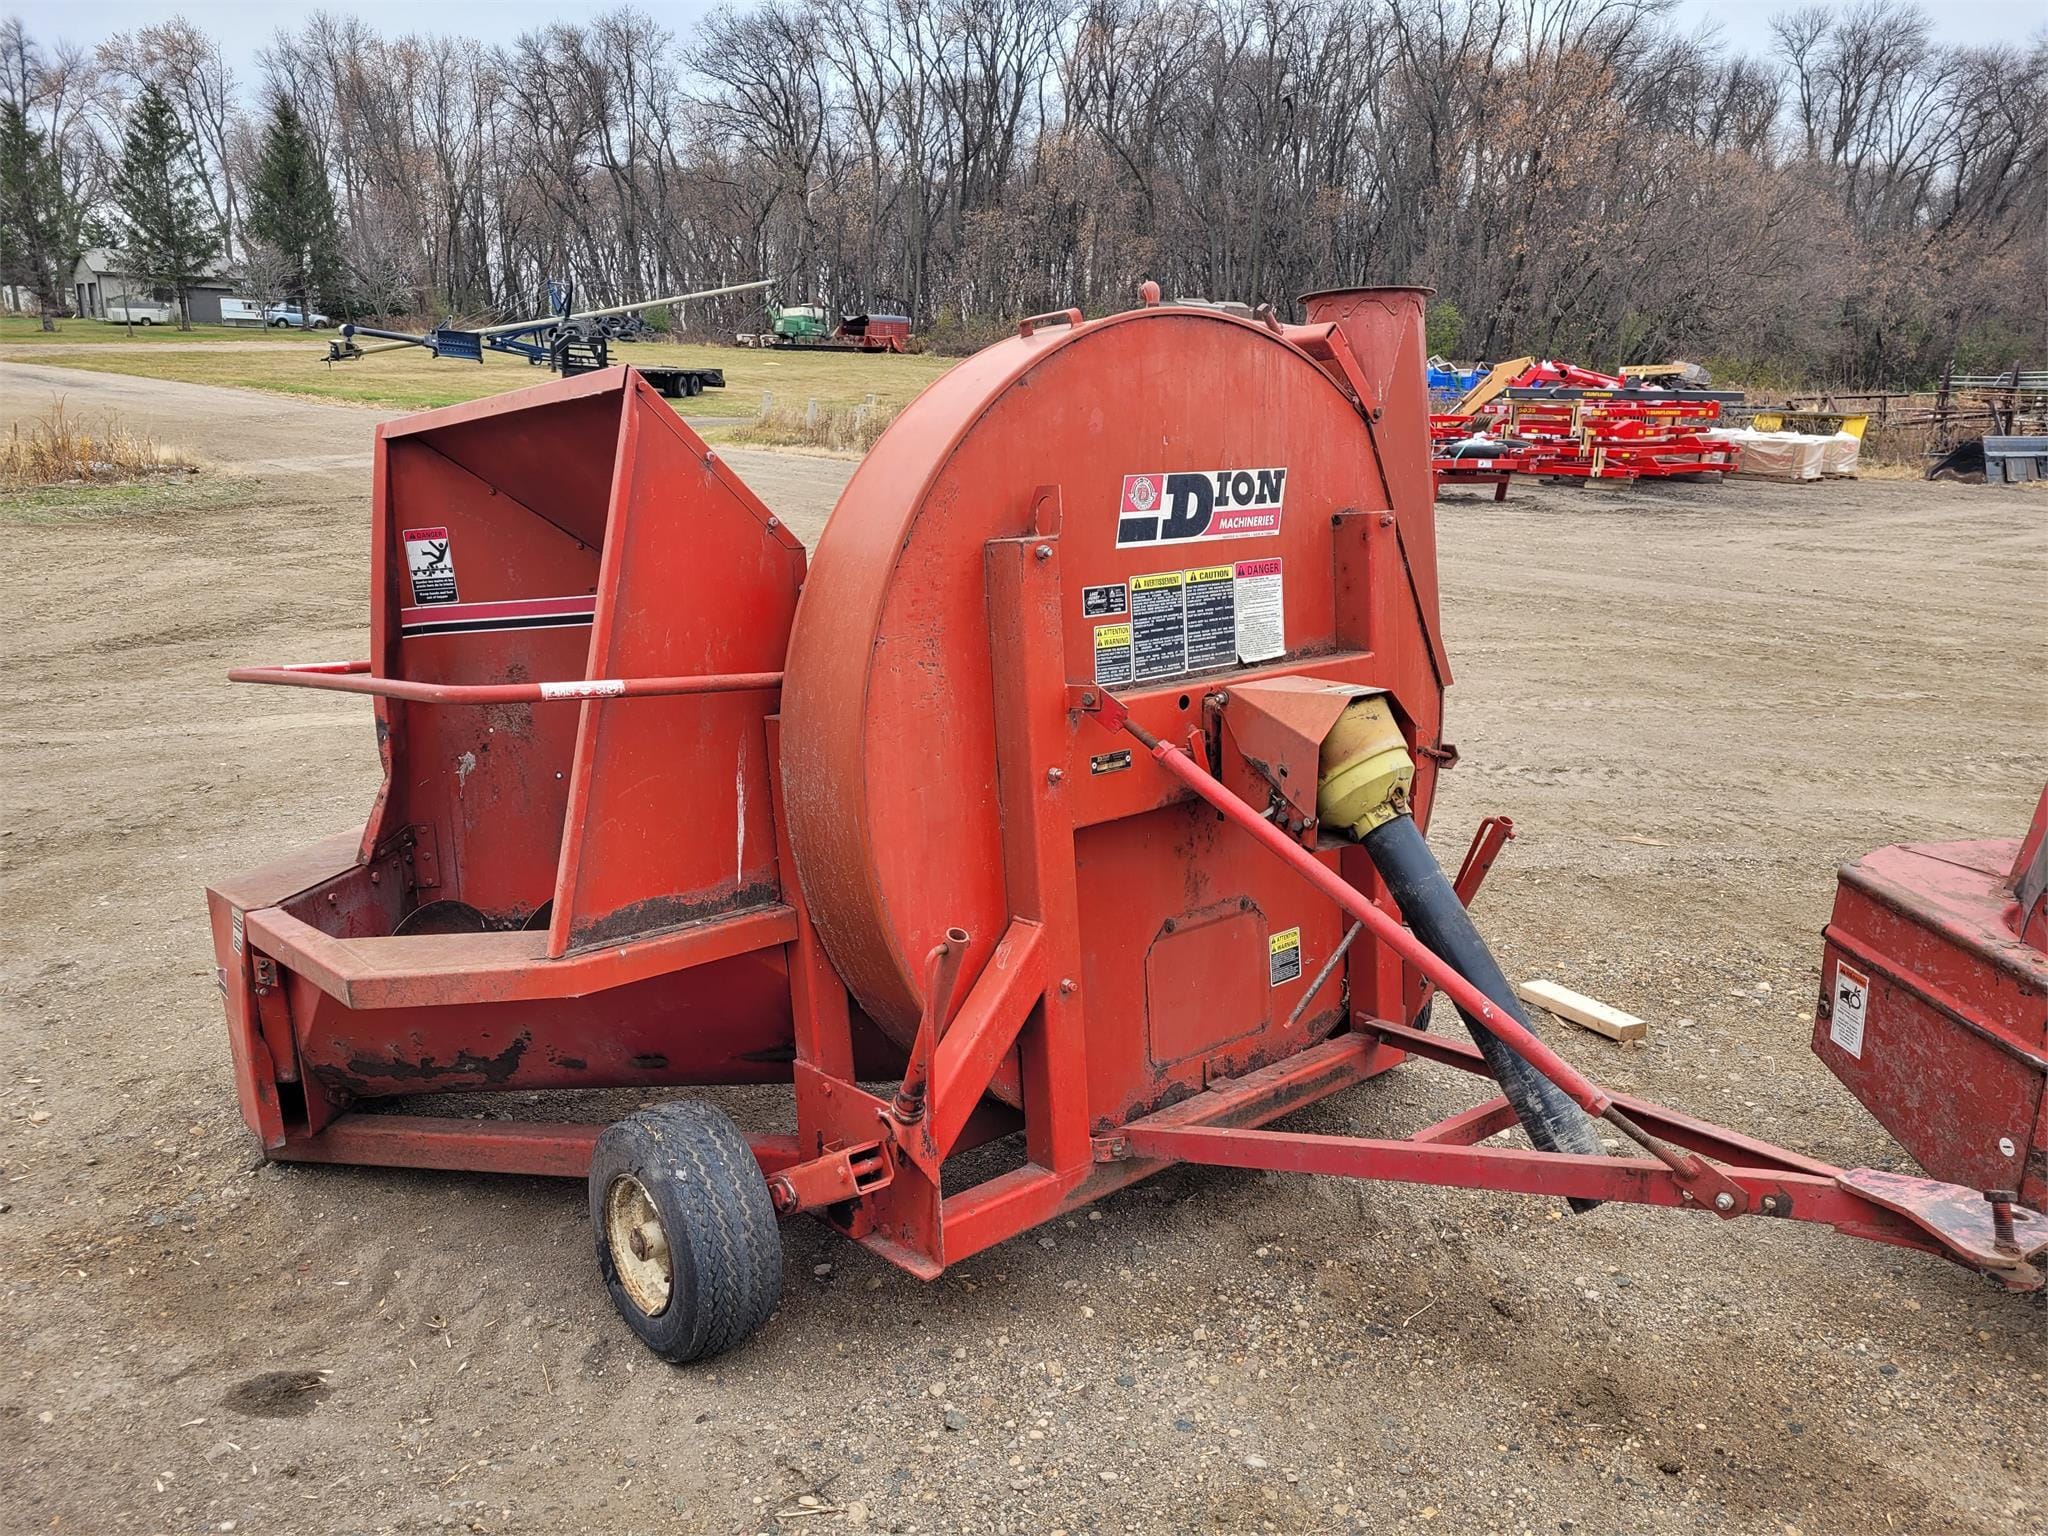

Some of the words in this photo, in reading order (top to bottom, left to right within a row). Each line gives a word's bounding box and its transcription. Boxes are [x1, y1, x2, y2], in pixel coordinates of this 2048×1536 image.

[1160, 469, 1285, 540] DION
[1219, 514, 1275, 530] MACHINERIES
[1199, 569, 1230, 580] CAUTION
[1247, 562, 1280, 576] DANGER
[1143, 576, 1180, 588] AVERTISSEMENT
[1103, 627, 1129, 637] ATTENTION
[1104, 637, 1129, 646] WARNING
